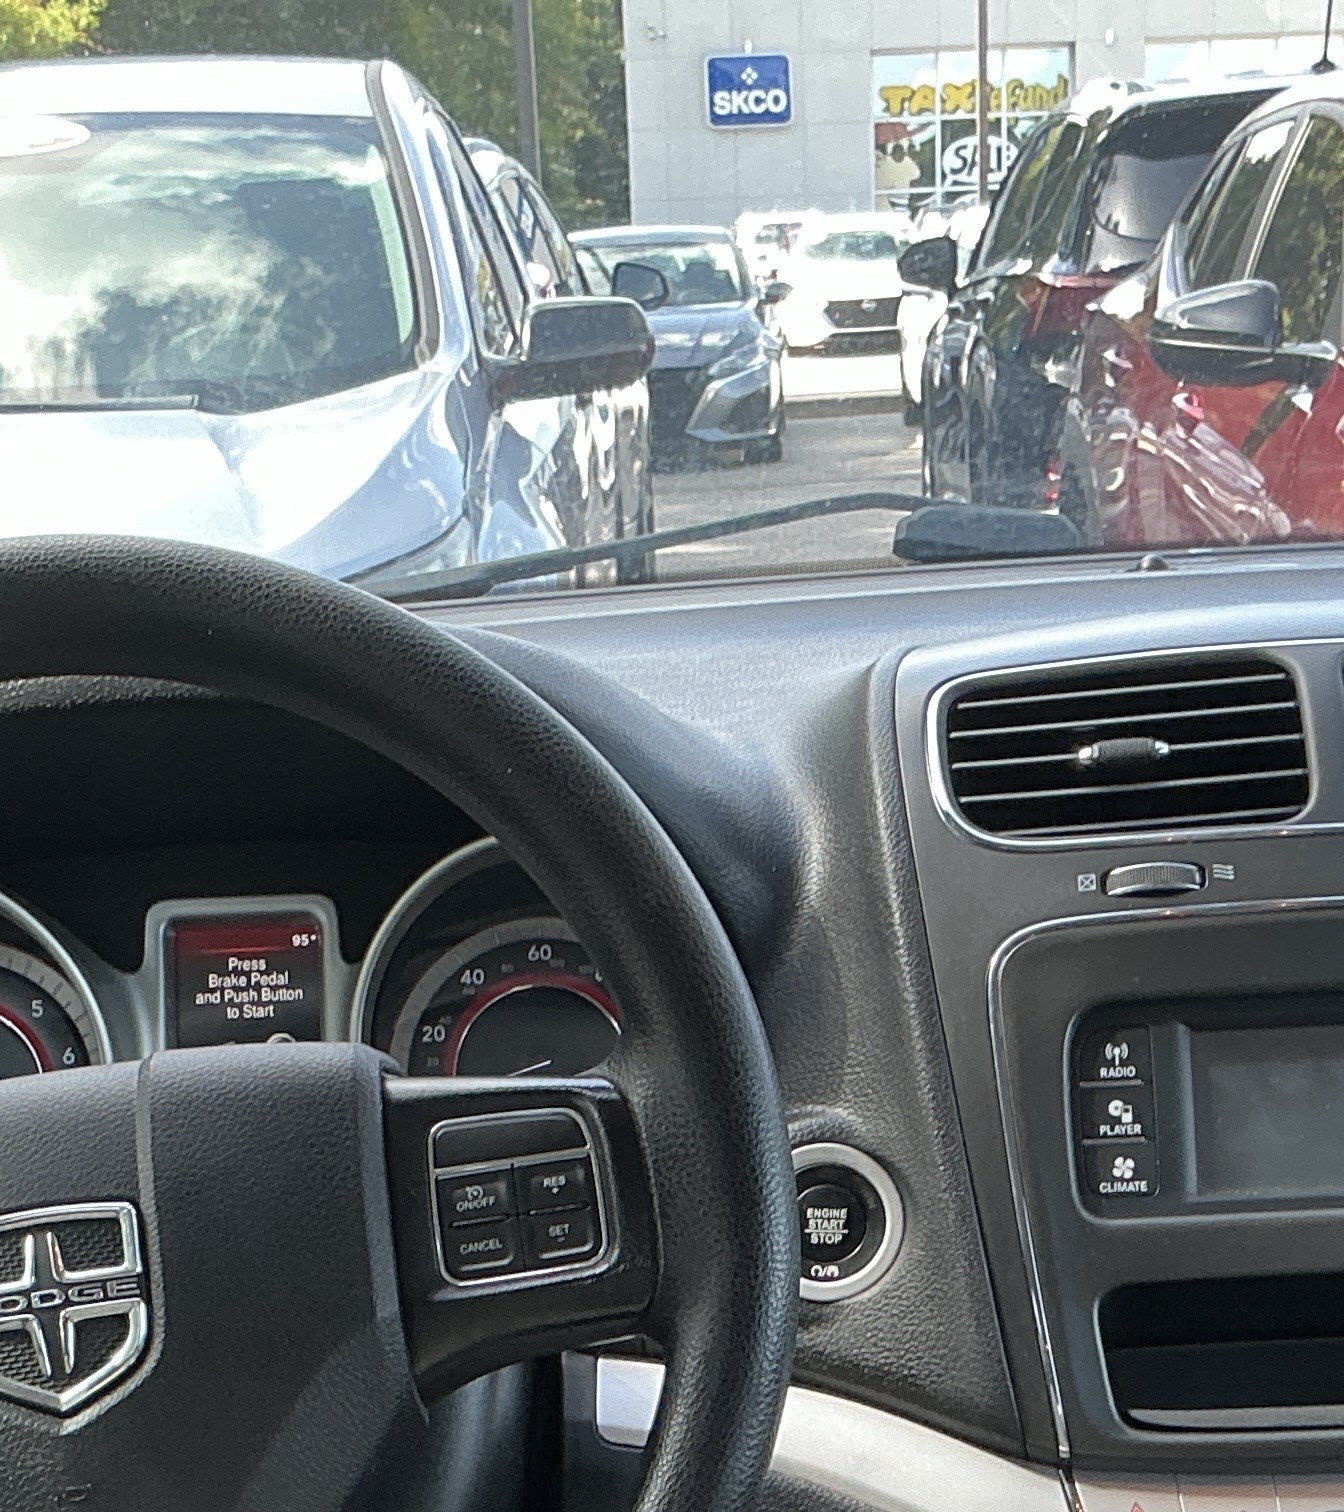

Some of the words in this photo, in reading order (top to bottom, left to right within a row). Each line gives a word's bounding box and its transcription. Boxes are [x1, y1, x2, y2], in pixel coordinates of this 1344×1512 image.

[713, 87, 788, 115] SKCO
[879, 82, 973, 117] TAX
[527, 944, 553, 962] 60
[228, 957, 267, 972] Press
[208, 973, 247, 989] Brake
[250, 970, 289, 986] Pedal
[459, 968, 485, 986] 40
[195, 990, 221, 1006] and
[224, 988, 258, 1003] Push
[261, 987, 304, 1001] Button
[31, 999, 44, 1018] 5
[226, 1006, 240, 1020] to
[243, 1004, 275, 1019] Start
[422, 1024, 447, 1043] 20
[62, 1046, 77, 1065] 6
[1099, 1065, 1137, 1079] RADIO
[1099, 1122, 1143, 1136] PLAYER
[543, 1175, 567, 1188] RES
[1098, 1179, 1149, 1194] CLIMATE
[806, 1207, 849, 1219] ENGINE
[548, 1223, 571, 1238] SET
[808, 1219, 846, 1231] START
[459, 1238, 504, 1255] CANCEL
[810, 1233, 843, 1245] STOP
